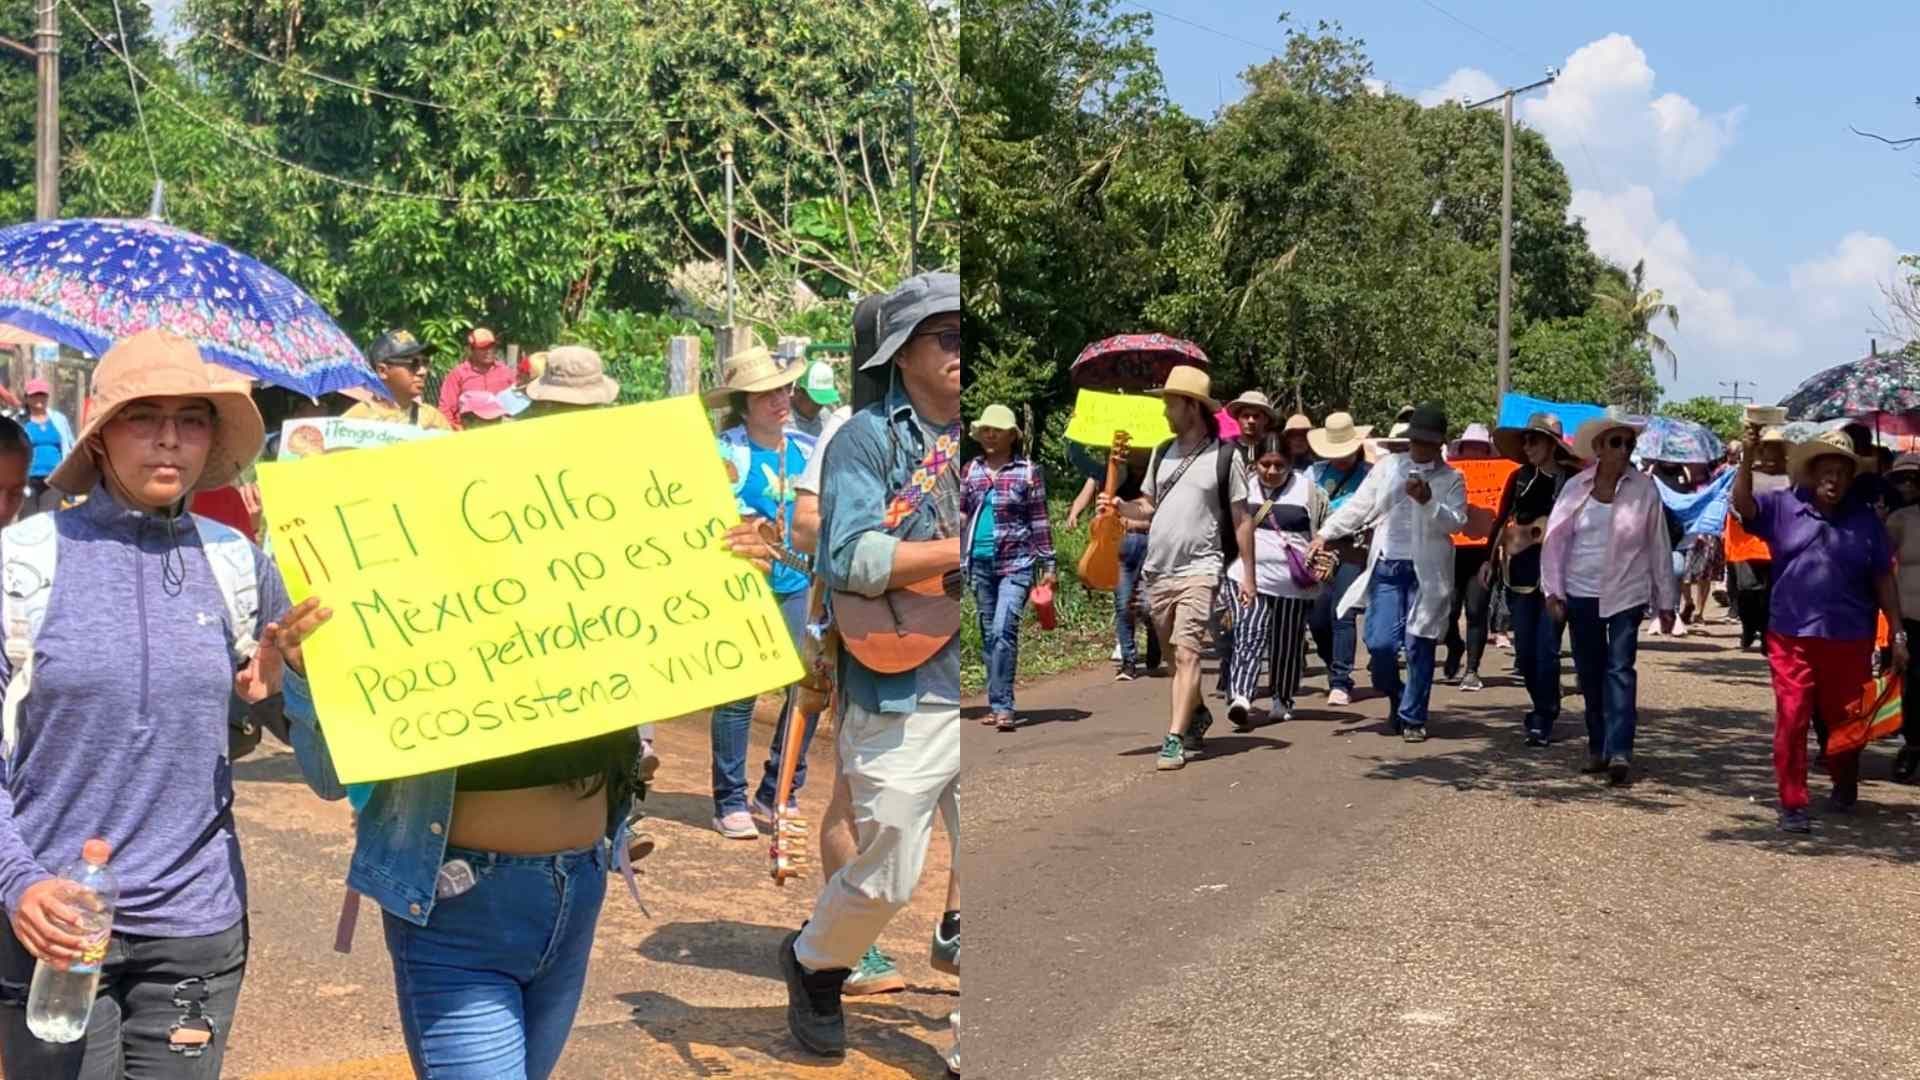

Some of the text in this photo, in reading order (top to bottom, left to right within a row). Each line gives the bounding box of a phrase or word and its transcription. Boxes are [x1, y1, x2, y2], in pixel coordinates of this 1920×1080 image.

[462, 469, 617, 545] Golfo
[644, 470, 693, 509] de
[547, 552, 605, 591] no
[624, 536, 671, 570] es
[683, 518, 727, 551] un
[664, 590, 711, 624] es
[724, 573, 762, 602] un
[389, 673, 632, 751] ecosistema
